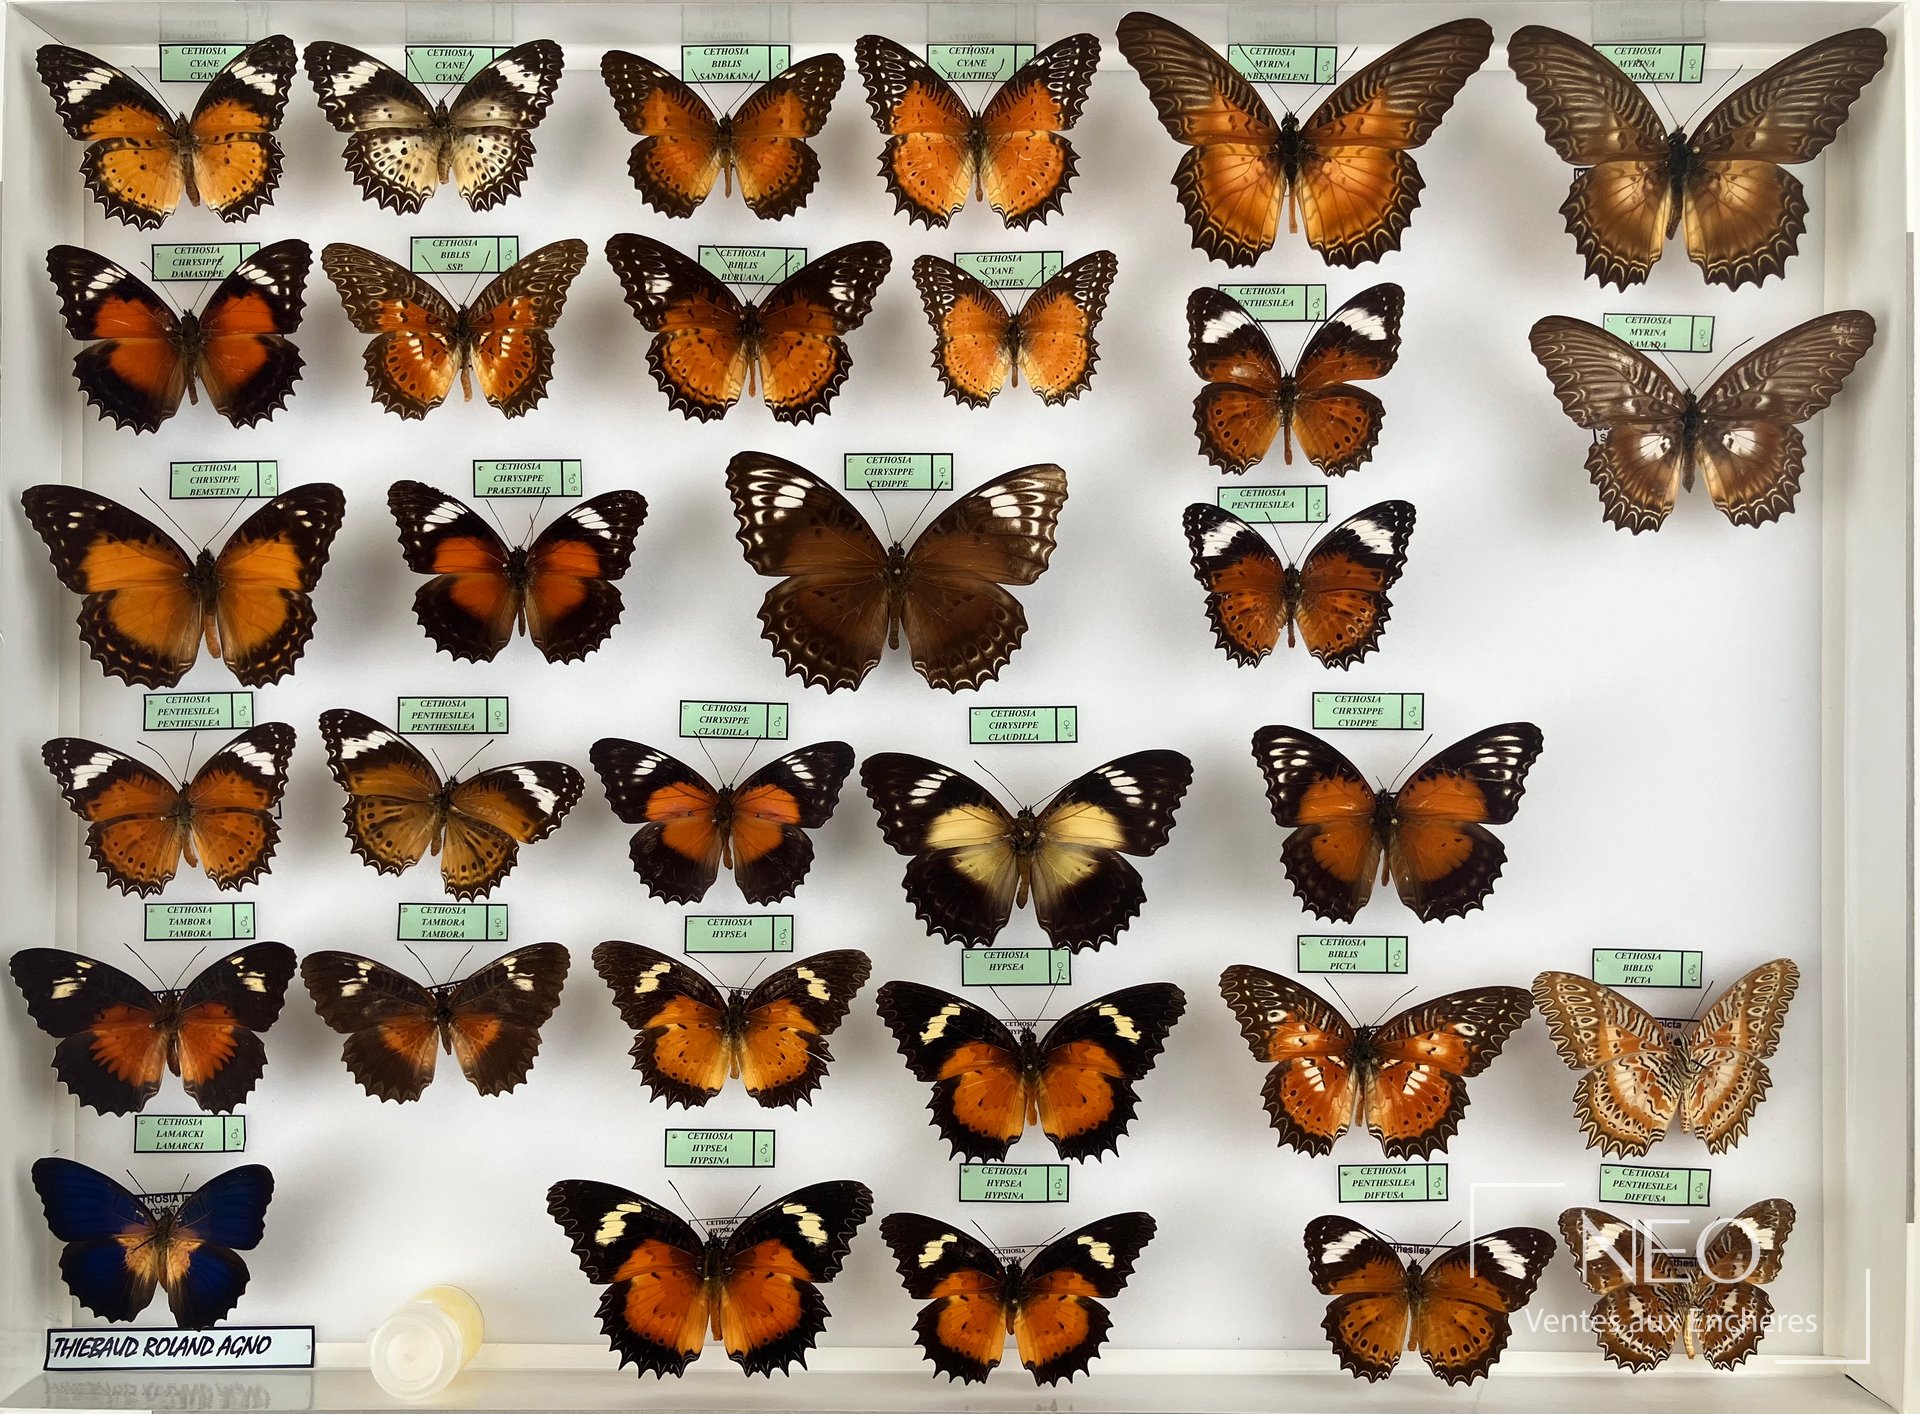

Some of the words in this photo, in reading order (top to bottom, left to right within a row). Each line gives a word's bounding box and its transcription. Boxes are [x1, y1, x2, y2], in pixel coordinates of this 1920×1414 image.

[426, 49, 474, 57] CETHOSIA
[703, 48, 750, 56] CETHOSIA
[948, 47, 995, 55] CETHOSIA
[1249, 48, 1296, 56] CETHOSIA
[1614, 47, 1662, 55] CETHOSIA
[711, 60, 742, 68] BIBLIS
[957, 59, 988, 67] CYANE
[1255, 60, 1291, 68] MYRINA
[1618, 60, 1655, 68] MYRINA
[699, 72, 754, 80] SANDAKANA
[947, 71, 998, 79] EUANTHES
[1241, 72, 1310, 81] ANBEMMELENI
[976, 255, 1022, 263] CETHOSIA
[446, 263, 464, 271] SSP.
[728, 262, 759, 270] BIBLIS
[171, 270, 224, 278] DAMASIPPE
[984, 267, 1014, 275] CYANE
[721, 274, 765, 282] BURUANA
[978, 279, 1025, 287] UANTHES
[1237, 299, 1295, 307] ENTHESILEA
[1625, 317, 1672, 325] CETHOSIA
[1629, 329, 1667, 337] MYRINA
[866, 456, 912, 464] CETHOSIA
[192, 464, 237, 472] CETHOSIA
[495, 463, 541, 471] CETHOSIA
[864, 468, 915, 476] CHRYSIPPE
[190, 476, 241, 484] CHRYSIPPE
[870, 480, 909, 488] CYDIPPE
[190, 488, 240, 496] BEMSTEINI
[1239, 489, 1286, 497] CETHOSIA
[1231, 501, 1295, 509] PENTHESILEA
[165, 696, 211, 704] CETHOSIA
[420, 700, 466, 708] CETHOSIA
[157, 708, 220, 716] PENTHESILEA
[702, 704, 747, 712] CETHOSIA
[1332, 707, 1384, 715] CHRYSIPPE
[411, 712, 475, 720] PENTHESILEA
[699, 716, 750, 724] CHRYSIPPE
[157, 719, 221, 728] PENTHESILEA
[1338, 719, 1378, 727] CYDIPPE
[698, 728, 750, 736] CLAUDILLA
[167, 906, 213, 914] CETHOSIA
[420, 906, 467, 914] CETHOSIA
[169, 918, 212, 926] TAMBORA
[168, 930, 212, 938] TAMBORA
[421, 930, 465, 938] TAMBORA
[712, 930, 748, 938] HYPSEA
[1319, 939, 1367, 947] CETHOSIA
[1614, 952, 1662, 960] CETHOSIA
[989, 963, 1025, 971] HYPSEA
[1622, 964, 1654, 972] BIBLIS
[1624, 976, 1652, 984] PICTA
[157, 1118, 203, 1126] CETHOSIA
[156, 1130, 204, 1138] LAMARCKI
[156, 1142, 204, 1150] LAMARCKI
[690, 1157, 730, 1165] HYPSINA
[1360, 1167, 1407, 1175] CETHOSIA
[1621, 1168, 1670, 1178] CETHOSIA
[1352, 1179, 1416, 1187] PENTHESILEA
[1612, 1180, 1678, 1191] PENTHESILEA
[984, 1192, 1024, 1200] HYPSINA
[1364, 1191, 1405, 1199] DIFFUSA
[1624, 1192, 1667, 1202] DIFFUSA
[53, 1335, 140, 1359] THIEBAUD
[142, 1335, 215, 1358] ROLAND
[216, 1334, 272, 1358] AGNO
